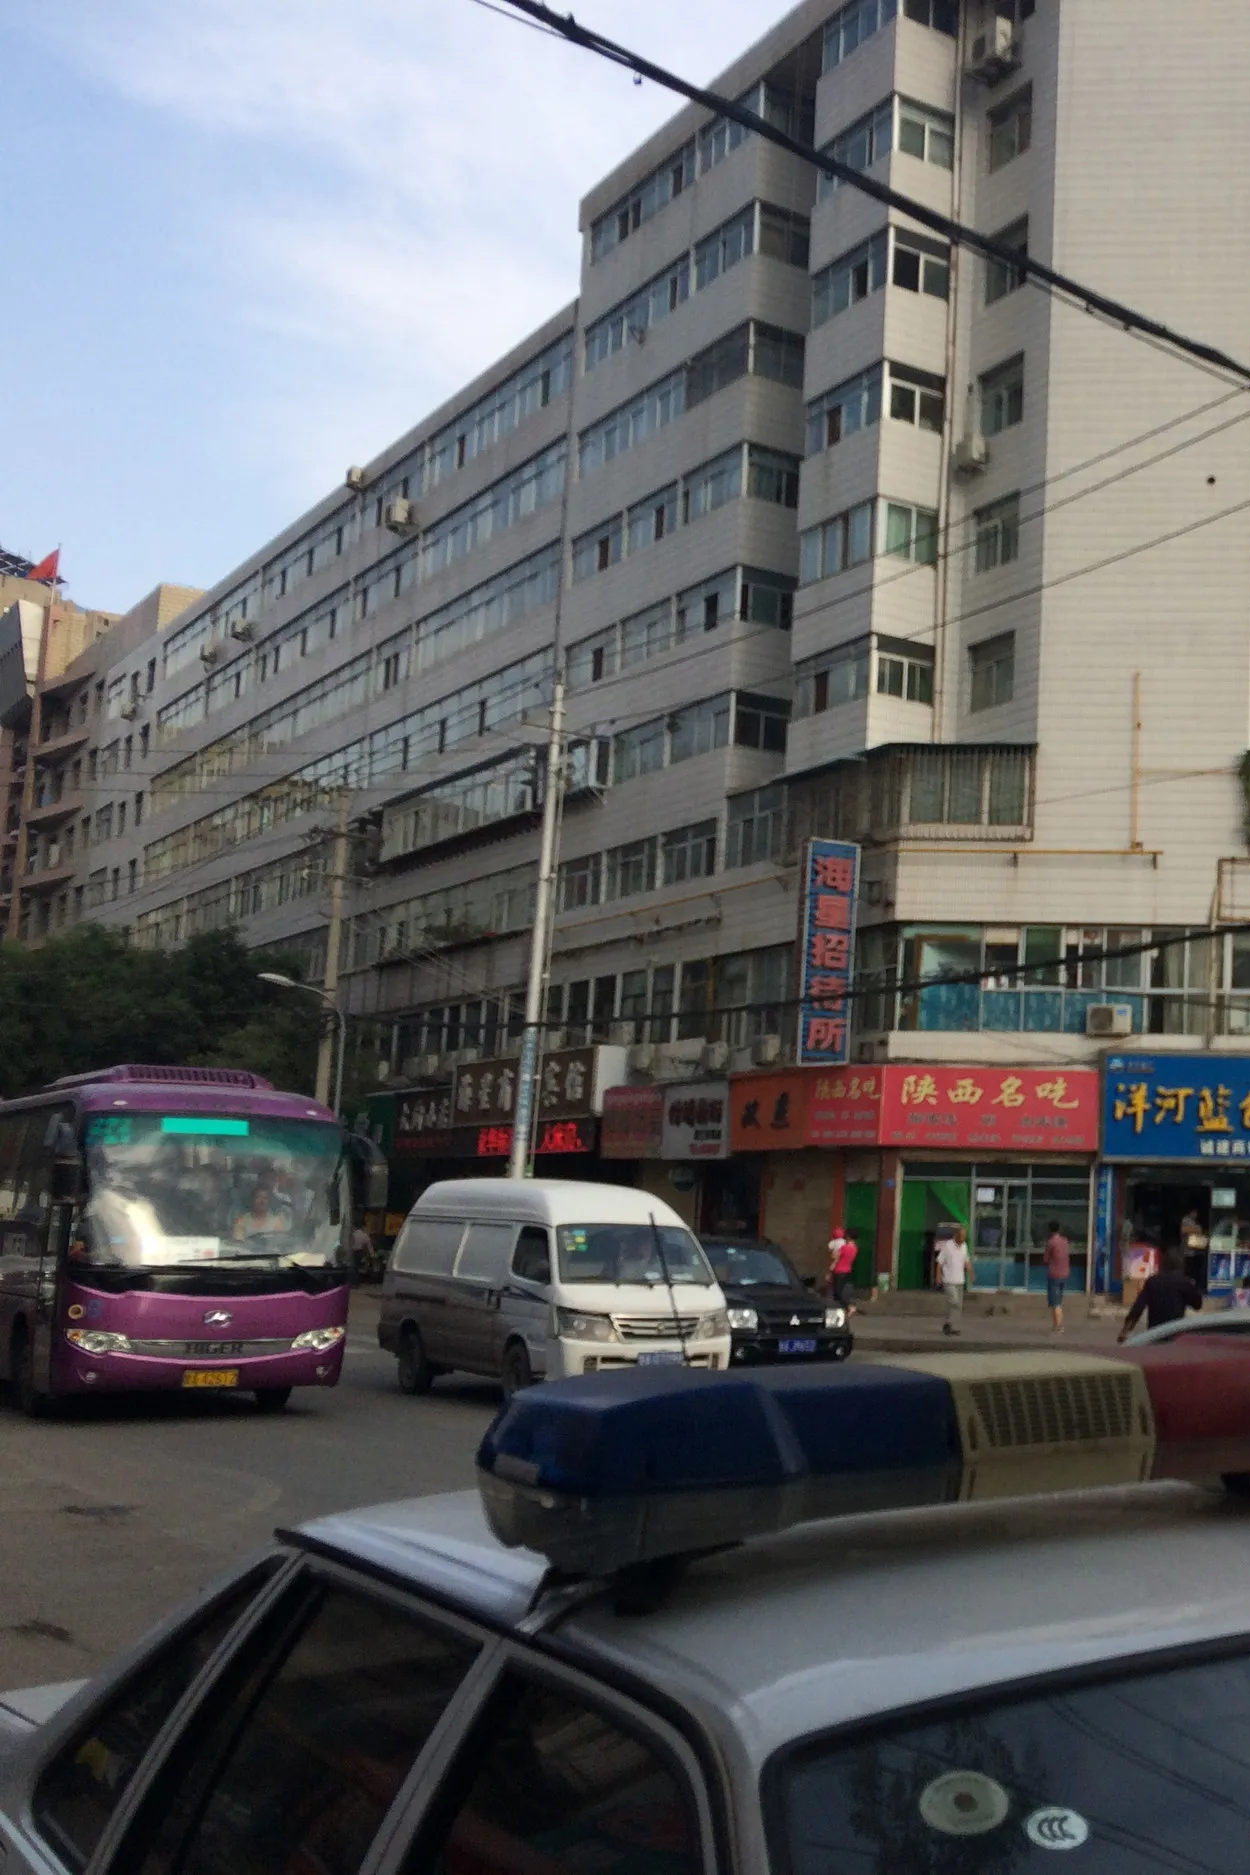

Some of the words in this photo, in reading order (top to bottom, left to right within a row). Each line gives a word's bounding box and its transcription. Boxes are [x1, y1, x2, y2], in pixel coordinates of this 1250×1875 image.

[806, 856, 856, 1053] 海星招待所
[901, 1073, 1081, 1109] 陕西名吃
